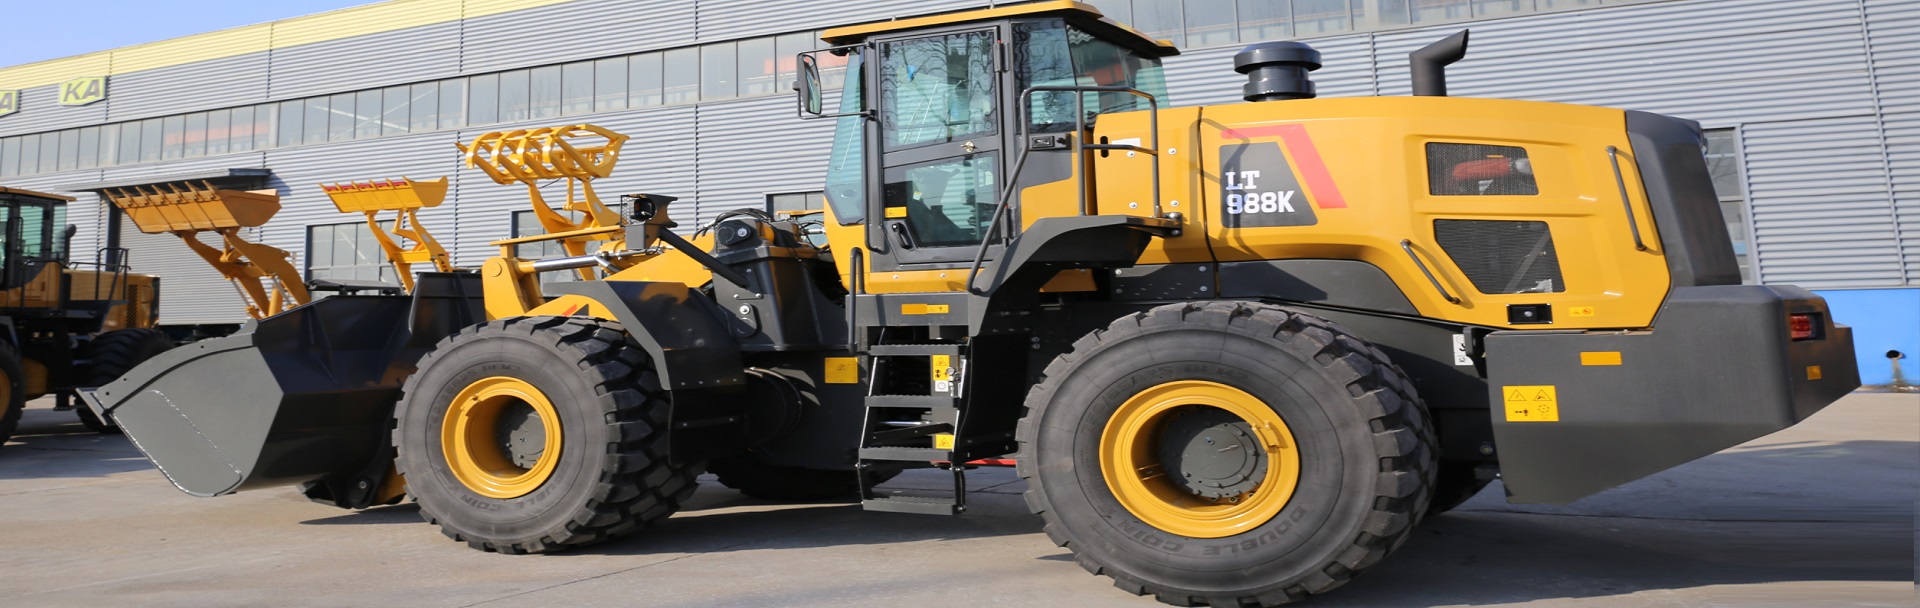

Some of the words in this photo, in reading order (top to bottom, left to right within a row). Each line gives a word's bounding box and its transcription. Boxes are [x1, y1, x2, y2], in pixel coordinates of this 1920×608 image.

[63, 79, 100, 102] KA
[1225, 170, 1260, 190] LT
[1226, 190, 1295, 215] 988K
[1116, 518, 1185, 553] COIN
[1203, 504, 1308, 555] DOUBLE
